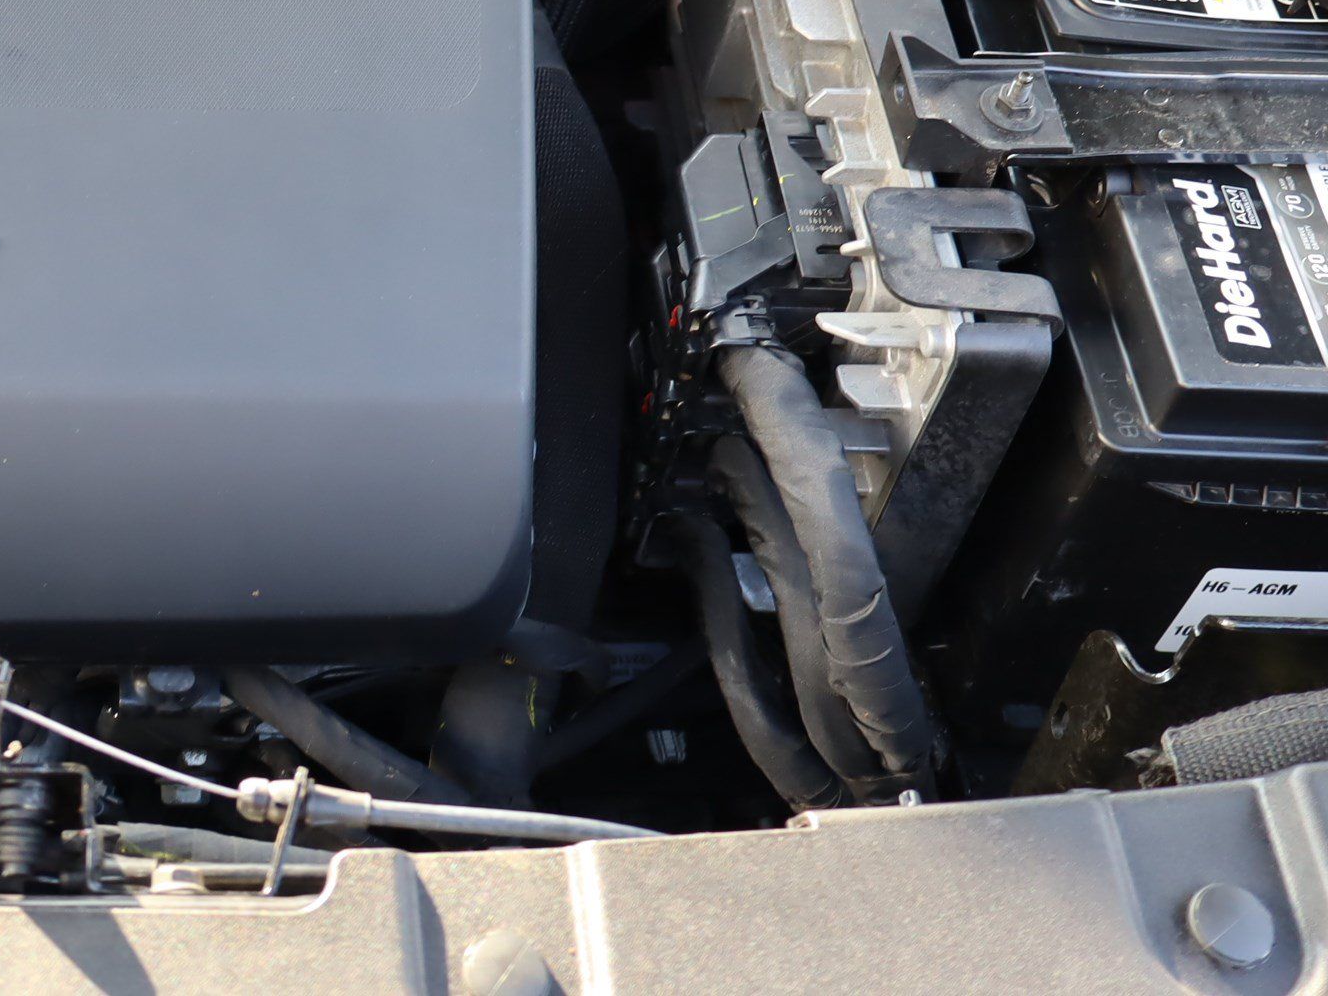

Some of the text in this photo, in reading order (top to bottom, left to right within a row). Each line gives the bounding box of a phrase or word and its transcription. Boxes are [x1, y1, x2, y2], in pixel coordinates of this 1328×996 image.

[1227, 188, 1249, 225] AGM
[1284, 194, 1307, 213] 70
[1172, 178, 1272, 349] DieHard
